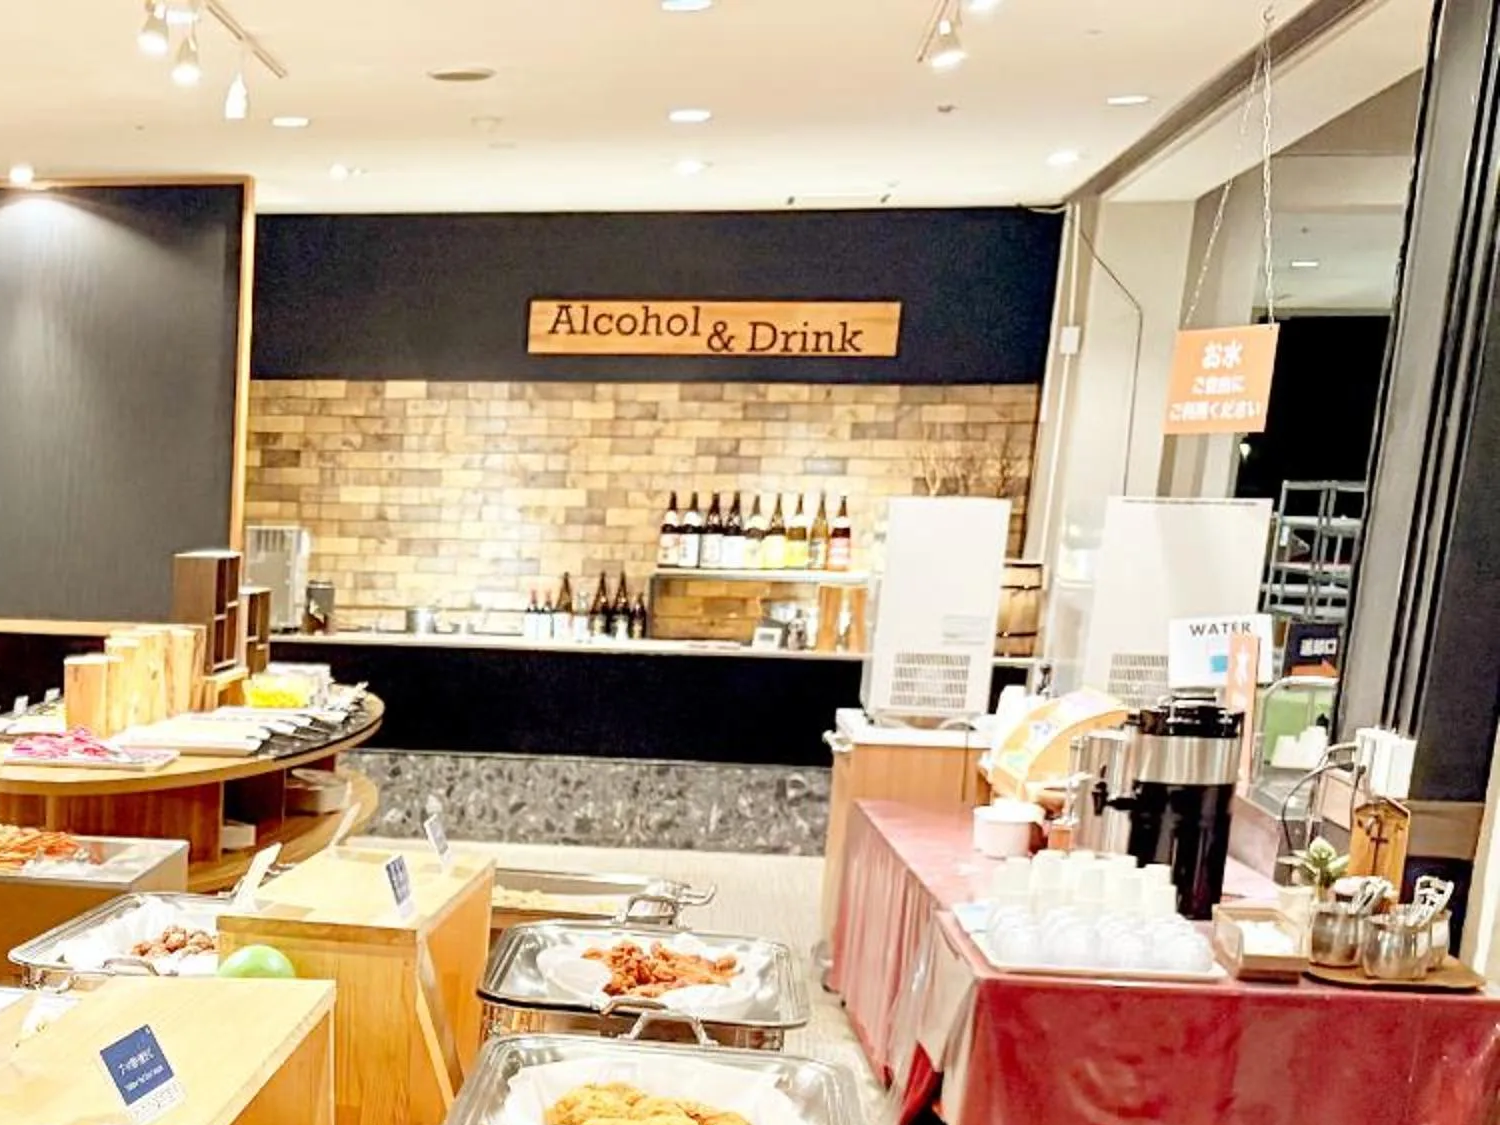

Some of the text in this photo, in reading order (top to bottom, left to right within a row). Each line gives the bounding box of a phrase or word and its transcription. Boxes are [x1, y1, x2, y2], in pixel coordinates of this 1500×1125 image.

[548, 304, 864, 354] Alcohol & Drink
[1202, 337, 1244, 370] お水
[1189, 621, 1252, 637] WATER
